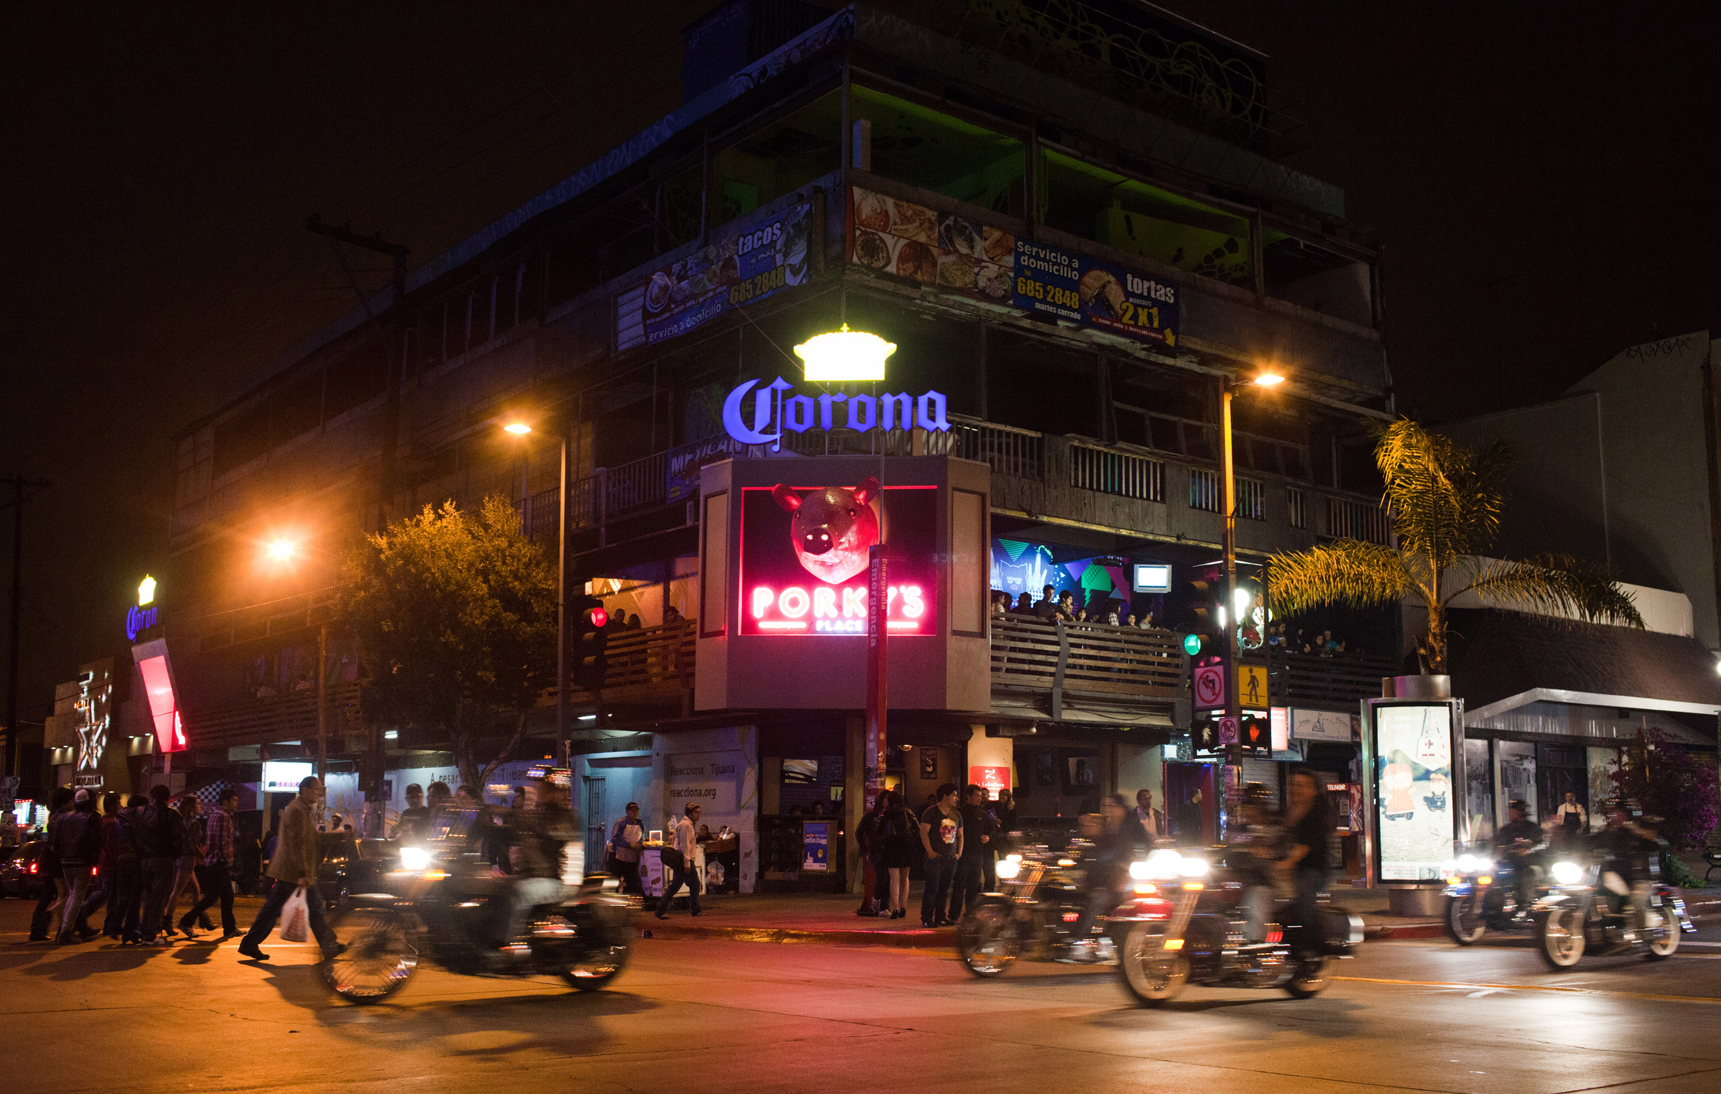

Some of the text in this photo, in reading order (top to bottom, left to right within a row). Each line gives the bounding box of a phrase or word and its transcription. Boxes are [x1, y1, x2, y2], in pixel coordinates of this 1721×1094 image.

[737, 221, 782, 256] tacos
[1016, 240, 1080, 269] Servicio a
[1020, 254, 1080, 281] domicilio
[729, 265, 785, 305] 685 2848
[1016, 276, 1080, 310] 685 2848
[1126, 273, 1175, 304] tortas
[722, 375, 953, 453] Corona
[870, 558, 880, 647] Emergencia
[816, 619, 863, 632] PLACE
[501, 767, 528, 783] Tijuan
[669, 763, 735, 776] Reacciona Tijuana
[669, 787, 717, 800] reacciona.org
